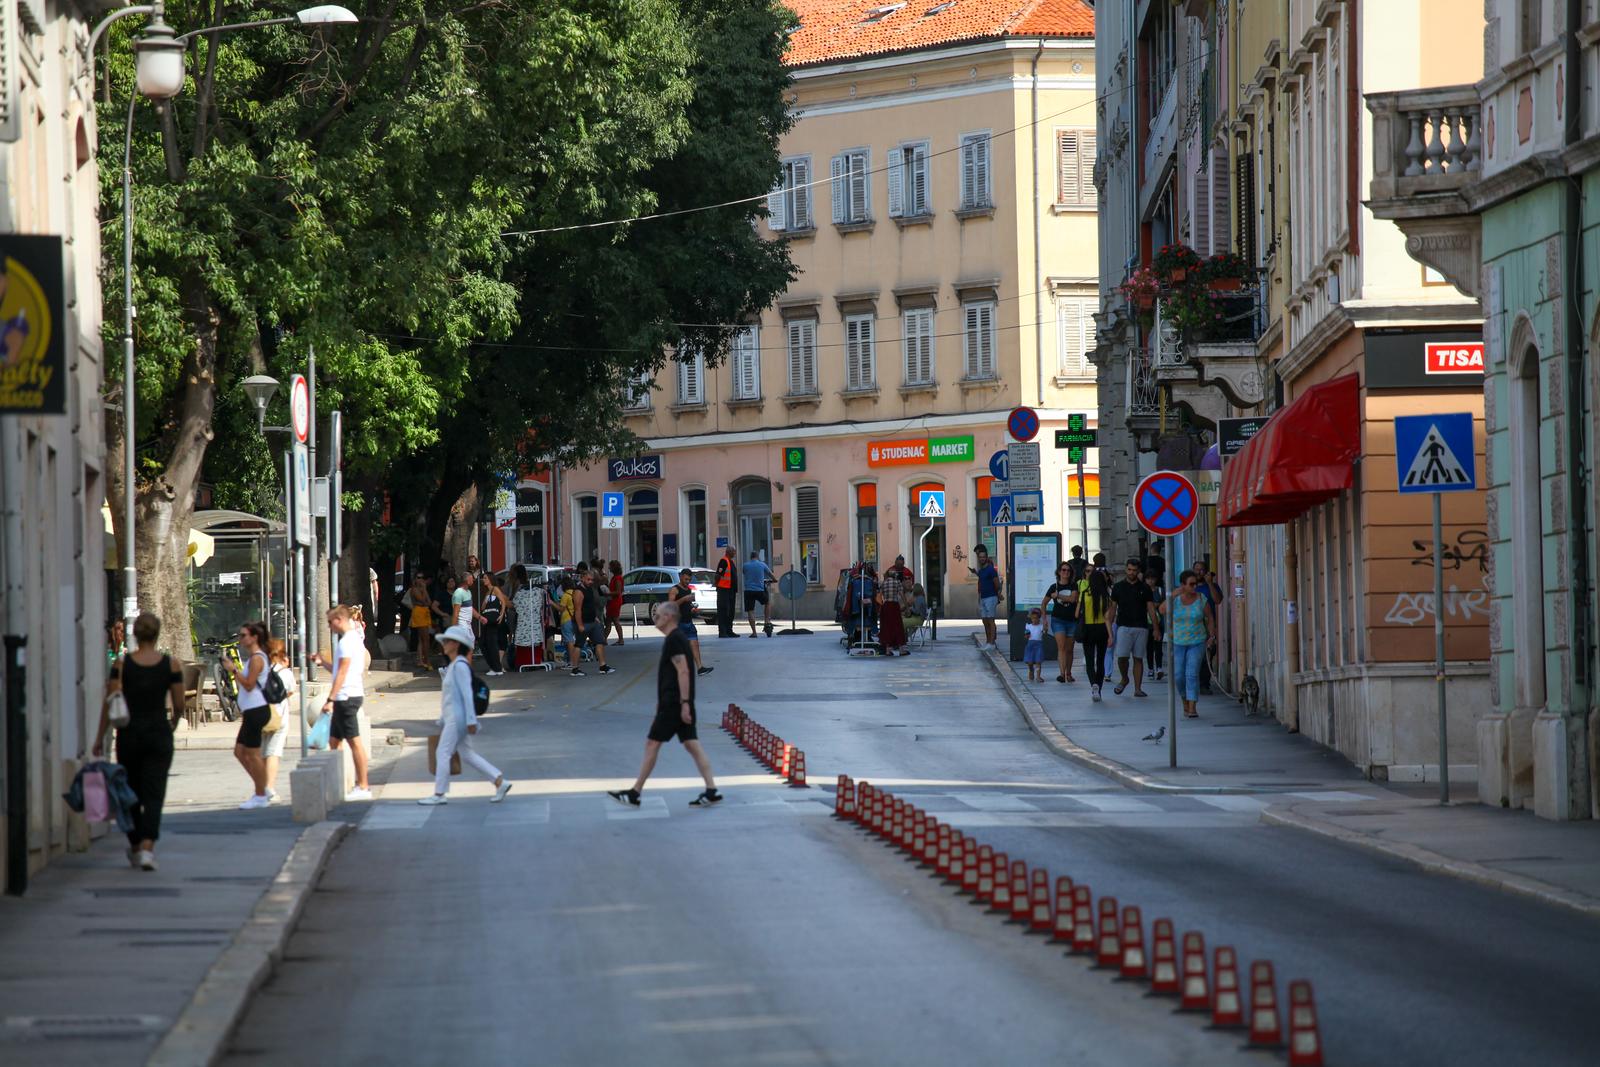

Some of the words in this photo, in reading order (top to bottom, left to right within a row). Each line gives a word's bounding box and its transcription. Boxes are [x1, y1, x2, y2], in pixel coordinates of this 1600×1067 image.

[1436, 350, 1483, 366] TISA
[1059, 434, 1094, 442] FARMACIA
[881, 446, 925, 460] STUDENAC
[931, 443, 969, 457] MARKET
[608, 497, 618, 512] P
